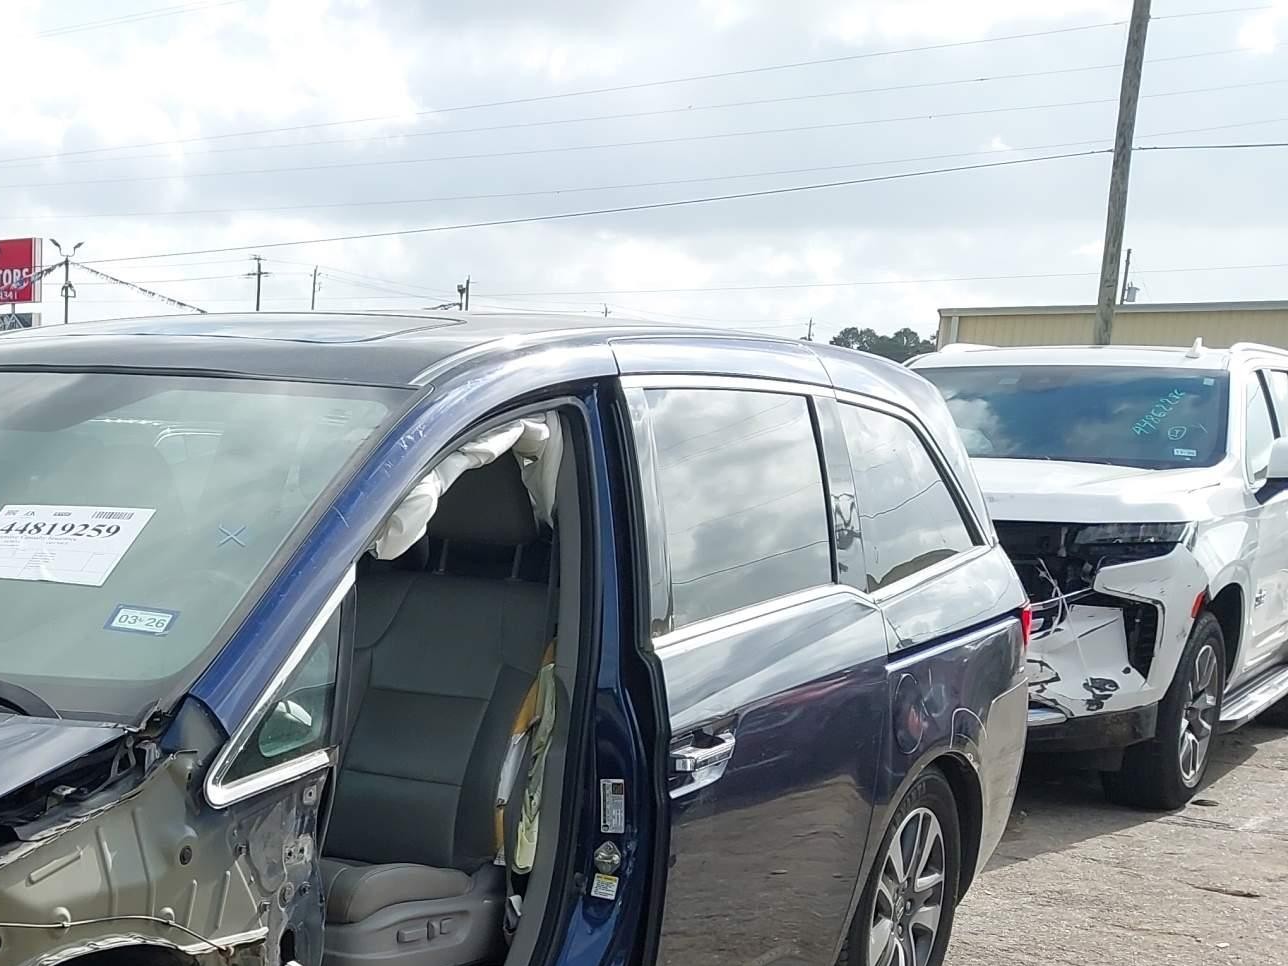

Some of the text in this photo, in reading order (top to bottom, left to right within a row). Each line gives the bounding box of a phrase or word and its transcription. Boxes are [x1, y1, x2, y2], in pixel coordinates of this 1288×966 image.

[0, 521, 121, 539] 44819259
[118, 614, 167, 628] 03 26
